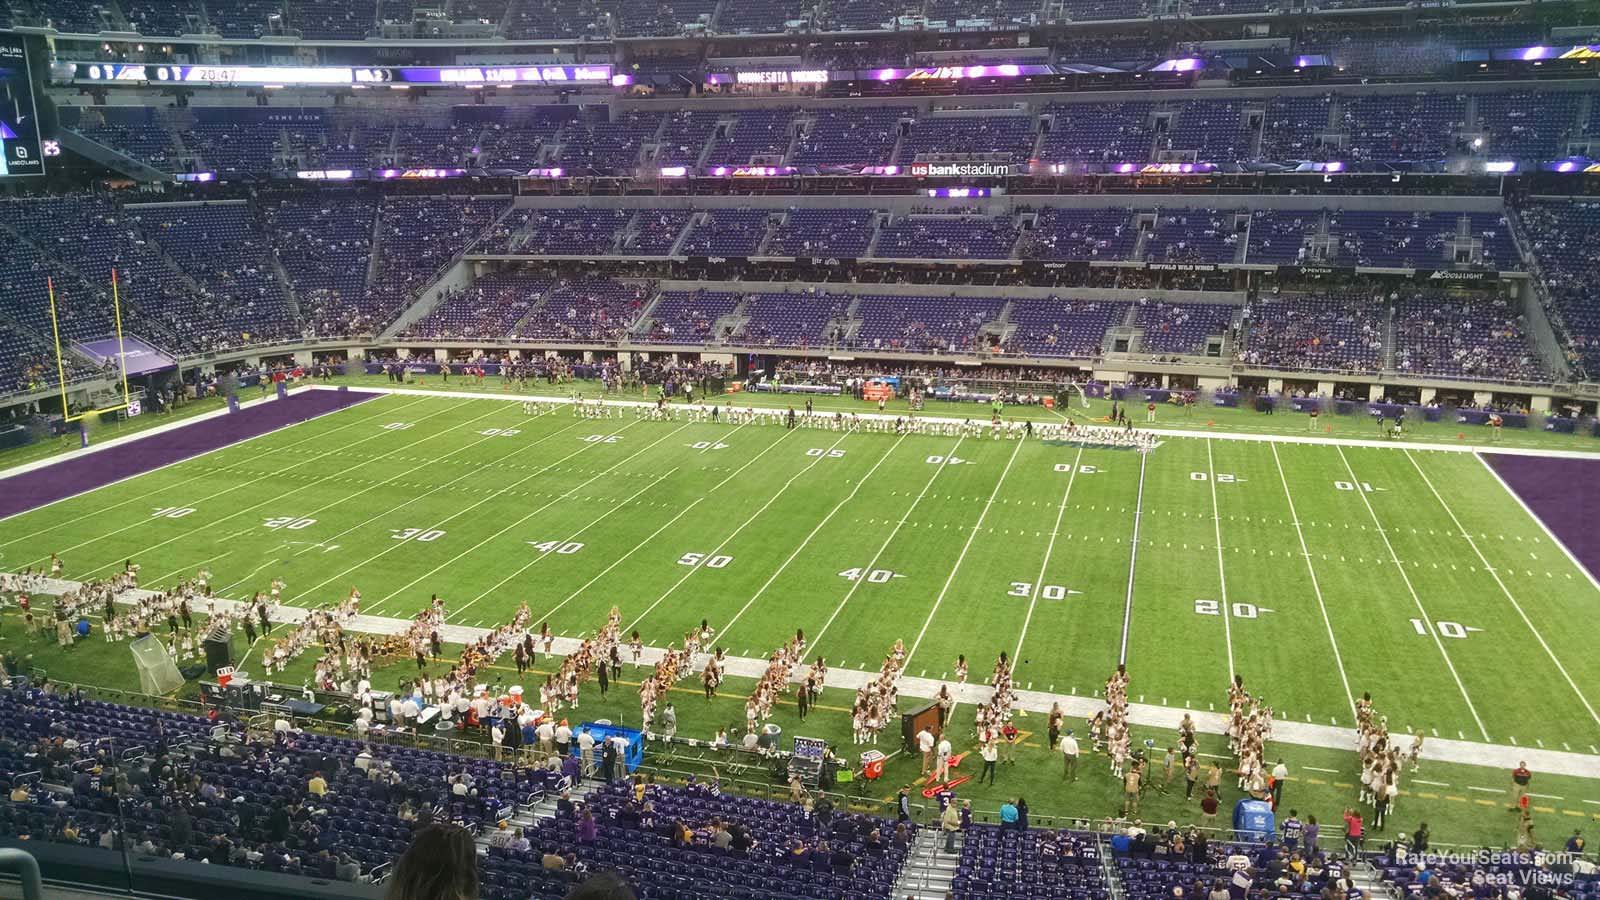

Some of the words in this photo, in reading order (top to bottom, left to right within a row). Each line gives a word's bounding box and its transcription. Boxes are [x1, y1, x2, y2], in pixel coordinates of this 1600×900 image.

[737, 71, 788, 83] MINNESOTA
[791, 70, 828, 82] VIKINGS
[44, 140, 60, 156] 25
[806, 448, 847, 458] 50
[161, 507, 196, 518] 10
[272, 517, 318, 529] 20
[397, 528, 447, 542] 30
[532, 541, 585, 554] 40
[677, 552, 734, 568] 50
[837, 567, 896, 583] 40
[1007, 582, 1066, 600] 30
[1194, 599, 1257, 618] 20
[1409, 618, 1468, 638] 10
